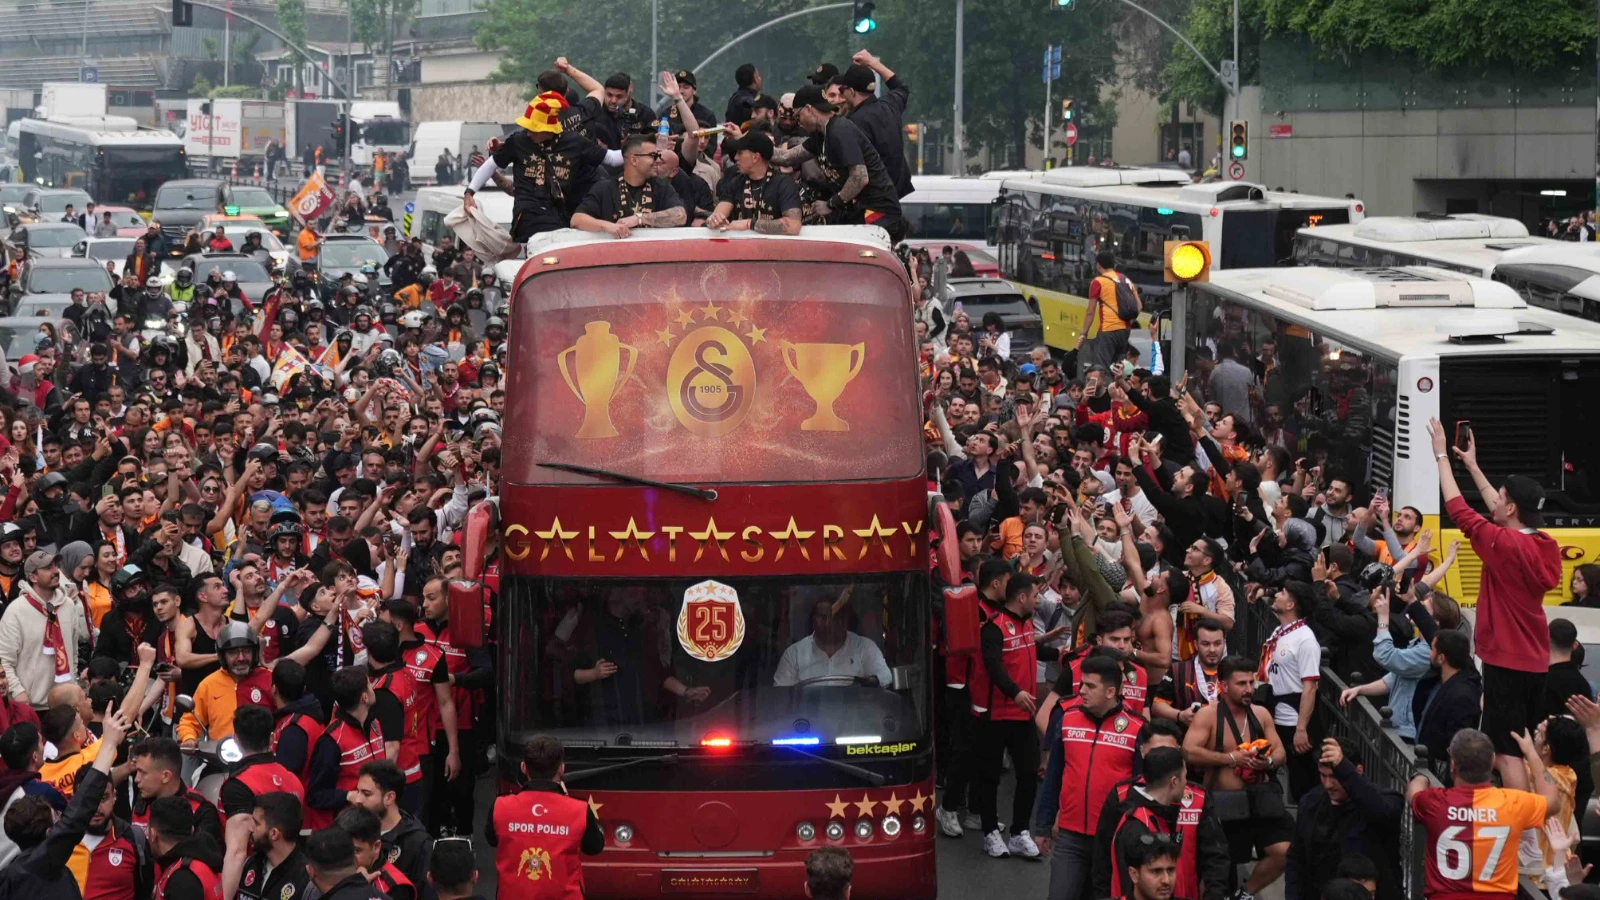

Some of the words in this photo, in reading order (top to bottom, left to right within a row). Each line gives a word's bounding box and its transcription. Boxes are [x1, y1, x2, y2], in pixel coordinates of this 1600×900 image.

[699, 385, 722, 394] 1905
[1543, 518, 1594, 526] ERY
[504, 513, 924, 563] GALATASARAY
[695, 606, 727, 641] 25
[1067, 729, 1086, 739] SPOR
[846, 742, 917, 756] bektaşlar
[1177, 812, 1199, 822] OLISI
[1447, 806, 1498, 822] SONER
[508, 822, 535, 833] SPOR
[1436, 825, 1511, 881] 67
